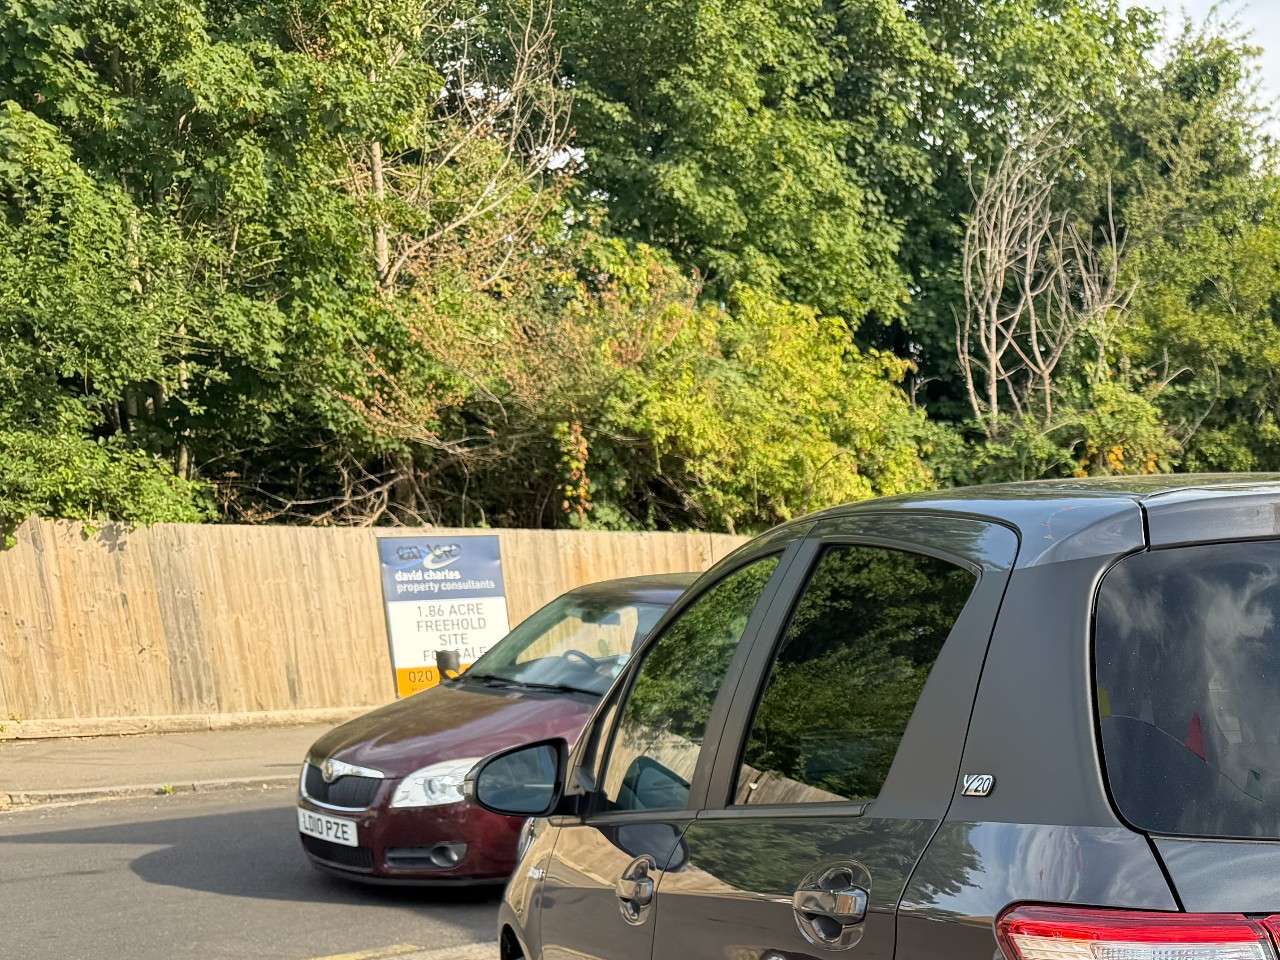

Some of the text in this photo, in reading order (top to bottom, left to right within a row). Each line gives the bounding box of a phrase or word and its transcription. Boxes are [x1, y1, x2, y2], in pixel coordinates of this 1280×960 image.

[395, 568, 462, 581] david charles
[396, 580, 496, 594] property consultants
[417, 603, 485, 618] 1.86 ACRE
[416, 617, 487, 632] FREEHOLD
[439, 633, 469, 647] SITE
[408, 671, 433, 683] 020
[325, 820, 350, 841] PZE
